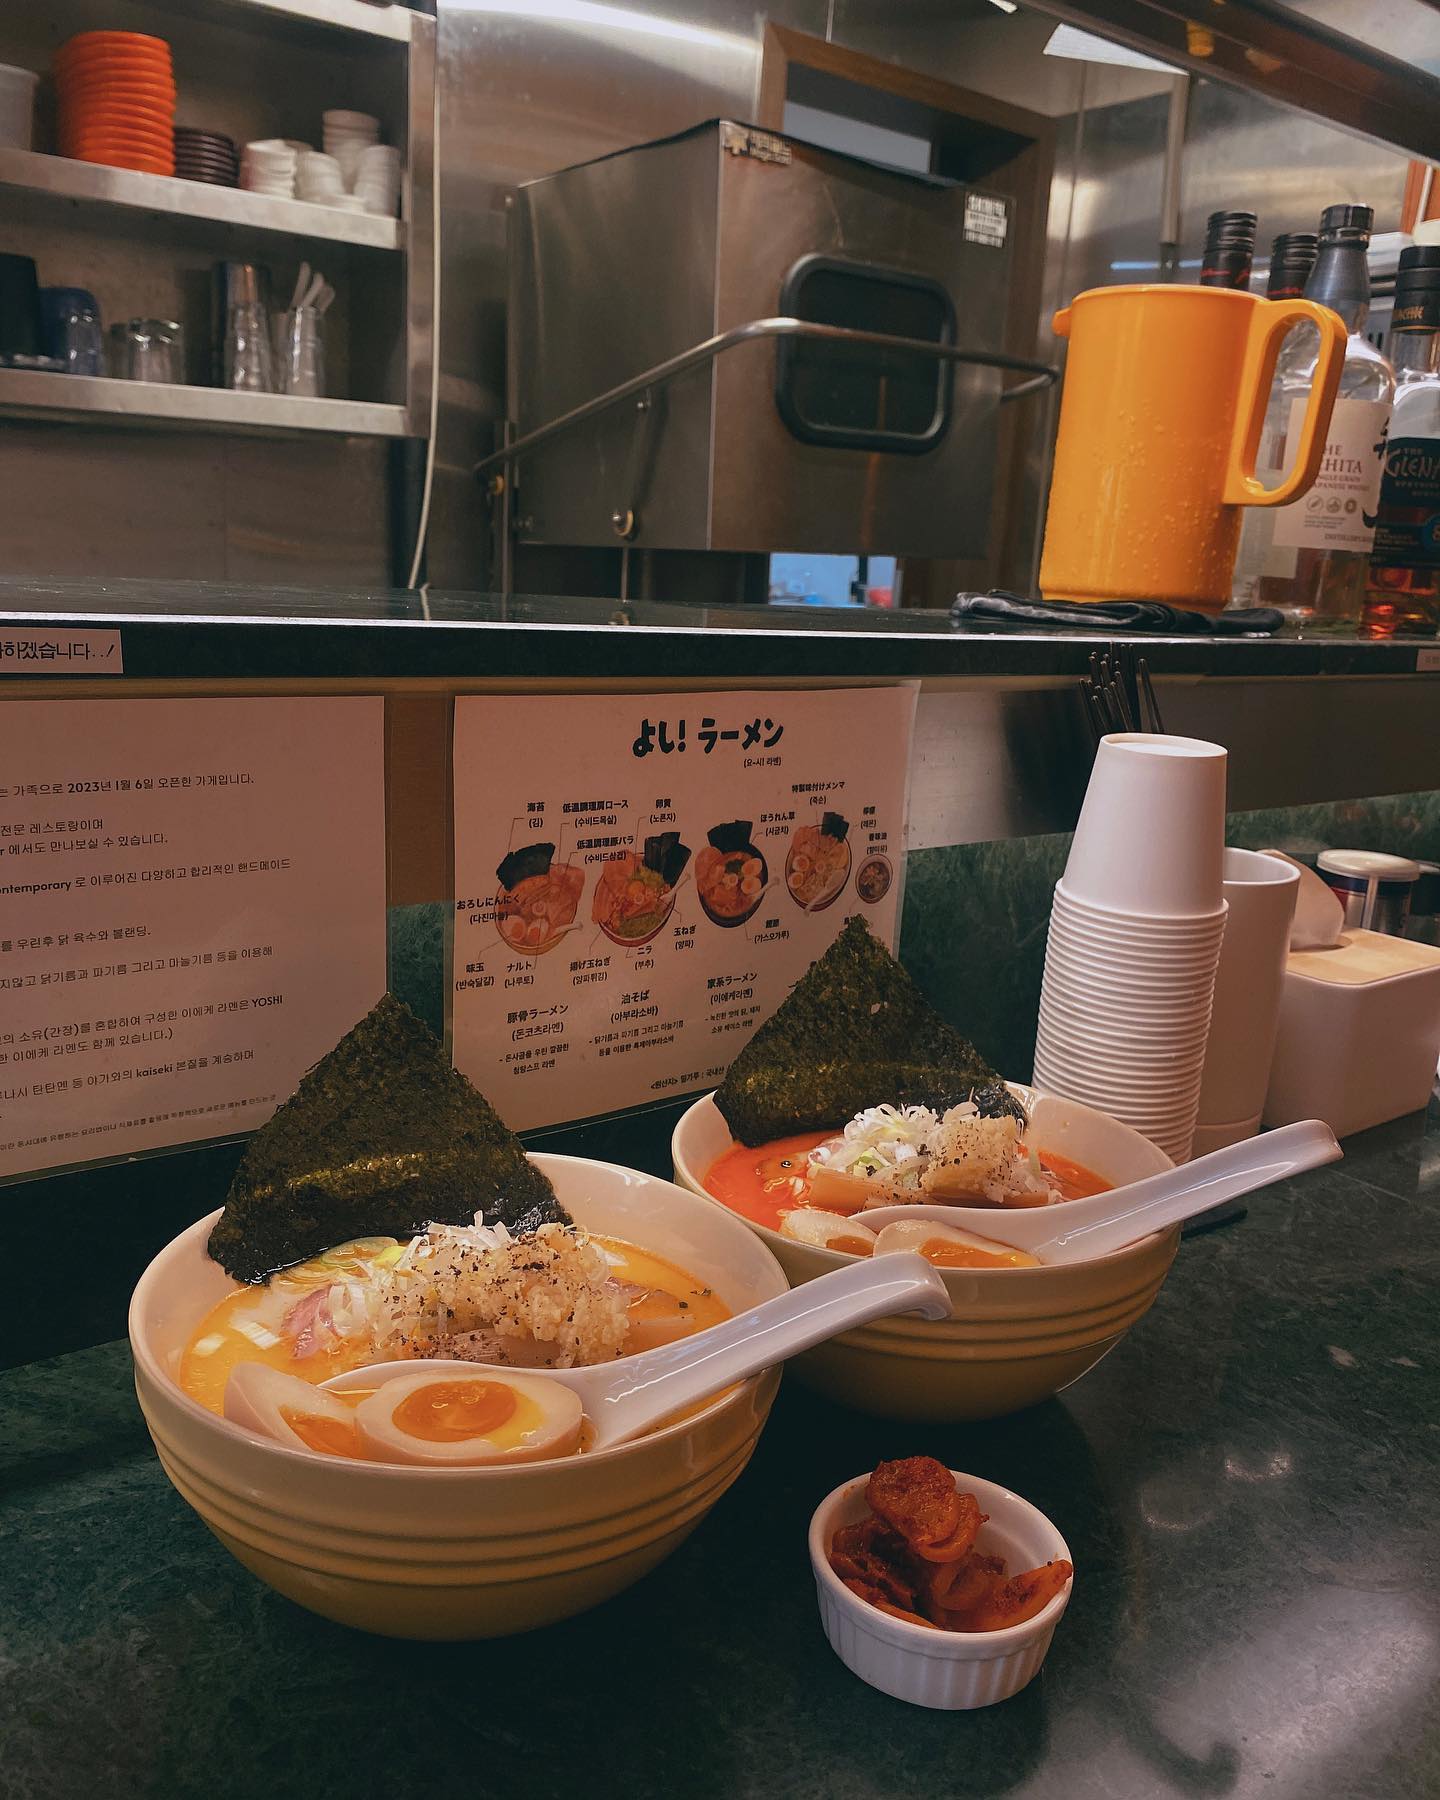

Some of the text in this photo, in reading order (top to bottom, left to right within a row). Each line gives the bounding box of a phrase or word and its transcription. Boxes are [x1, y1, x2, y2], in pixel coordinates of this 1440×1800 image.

[1325, 458, 1363, 475] HITA
[697, 717, 785, 755] ラーメン
[13, 784, 63, 798] 가족으로
[68, 781, 112, 795] 2023년
[115, 780, 131, 792] 1월
[135, 778, 154, 791] 6일
[158, 777, 192, 790] 오픈한
[196, 773, 255, 787] 가게입니다.
[528, 817, 544, 829] (김)
[575, 814, 618, 829] (수비드목살)
[650, 812, 677, 825] (노른자)
[0, 818, 104, 837] 전문 레스토랑이며
[765, 825, 789, 837] (시금치)
[8, 842, 47, 856] 에서도
[50, 837, 99, 852] 만나보실
[103, 837, 115, 849] 수
[119, 833, 169, 847] 있습니다.
[75, 877, 86, 889] 로
[91, 873, 138, 888] 이루어진
[142, 868, 188, 883] 다양하고
[191, 863, 235, 878] 합리적인
[239, 858, 292, 874] 핸드메이드
[456, 894, 520, 911] おろしにんにく
[673, 924, 697, 937] 玉ねぎ
[17, 935, 54, 950] 우린후
[73, 930, 109, 944] 육수와
[675, 939, 694, 951] (양파)
[637, 945, 653, 955] ニラ
[41, 969, 89, 985] 닭기름과
[93, 963, 127, 978] 파기름
[131, 959, 166, 973] 그리고
[169, 953, 214, 969] 마늘기름
[241, 945, 274, 959] 이용해
[506, 960, 533, 973] ナルト
[504, 975, 534, 990] (나루토)
[572, 971, 608, 986] (양파튀김)
[95, 1016, 142, 1032] 혼합하여
[181, 1004, 214, 1018] 이에케
[251, 994, 284, 1008] YOSHI
[610, 1005, 659, 1024] (아부라소바)
[12, 1047, 49, 1062] 이에케
[92, 1037, 115, 1051] 함께
[118, 1027, 174, 1047] 있습니다.)
[32, 1081, 69, 1097] 탄탄멘
[136, 1063, 174, 1079] kaiseki
[176, 1058, 209, 1073] 본질을
[212, 1050, 255, 1067] 계승하며
